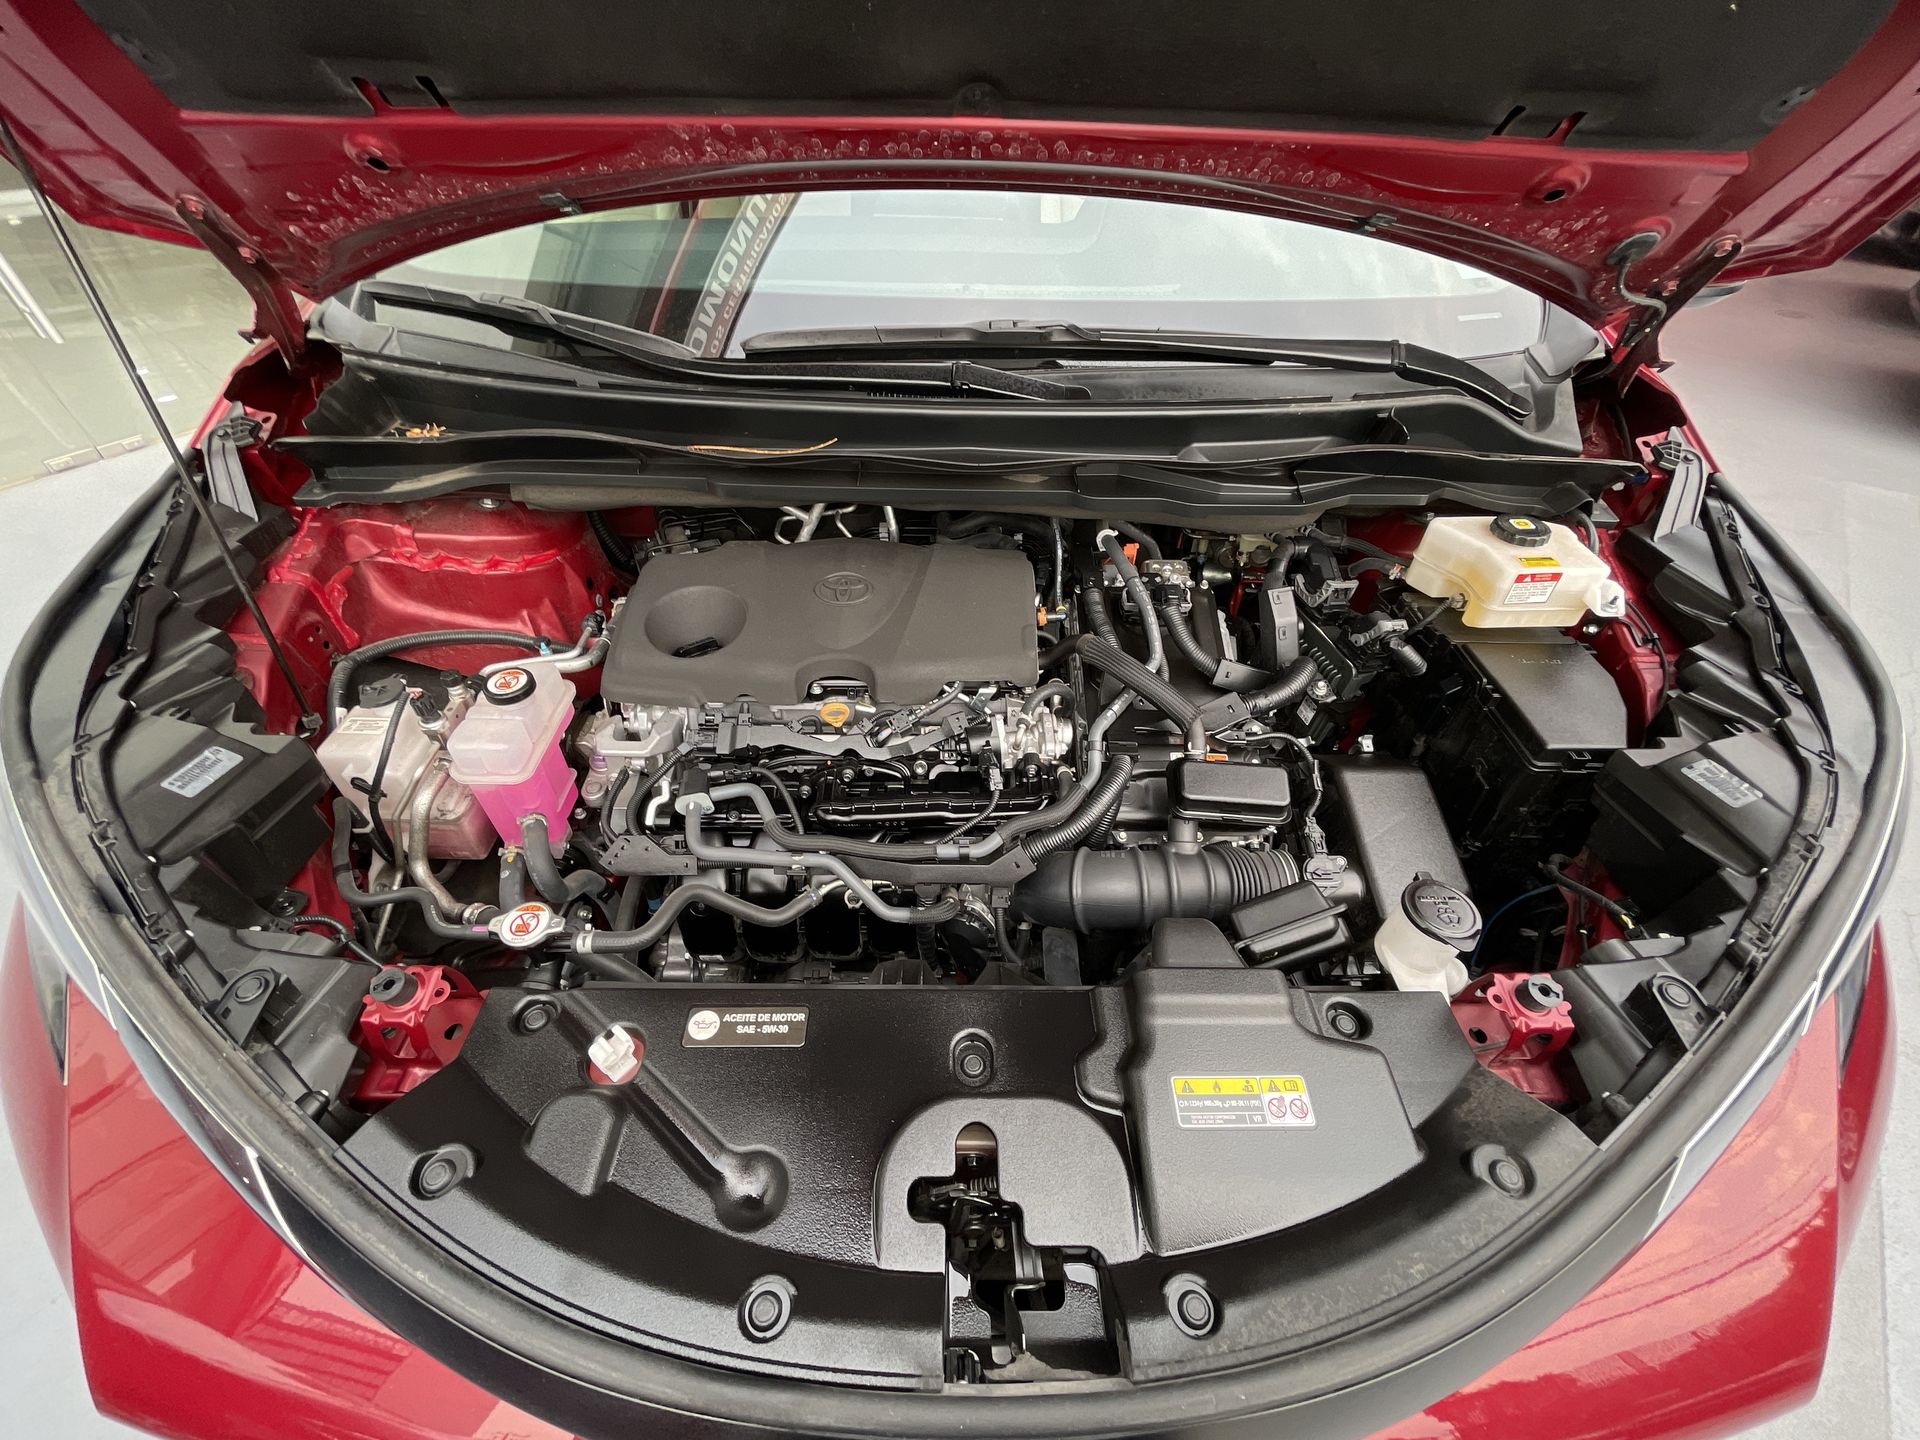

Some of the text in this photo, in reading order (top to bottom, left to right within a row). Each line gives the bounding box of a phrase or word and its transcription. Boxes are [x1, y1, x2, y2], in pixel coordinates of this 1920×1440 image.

[723, 1013, 806, 1022] ACEITE DE MOTOR
[736, 1025, 756, 1034] SAE
[761, 1025, 789, 1034] 5W-30
